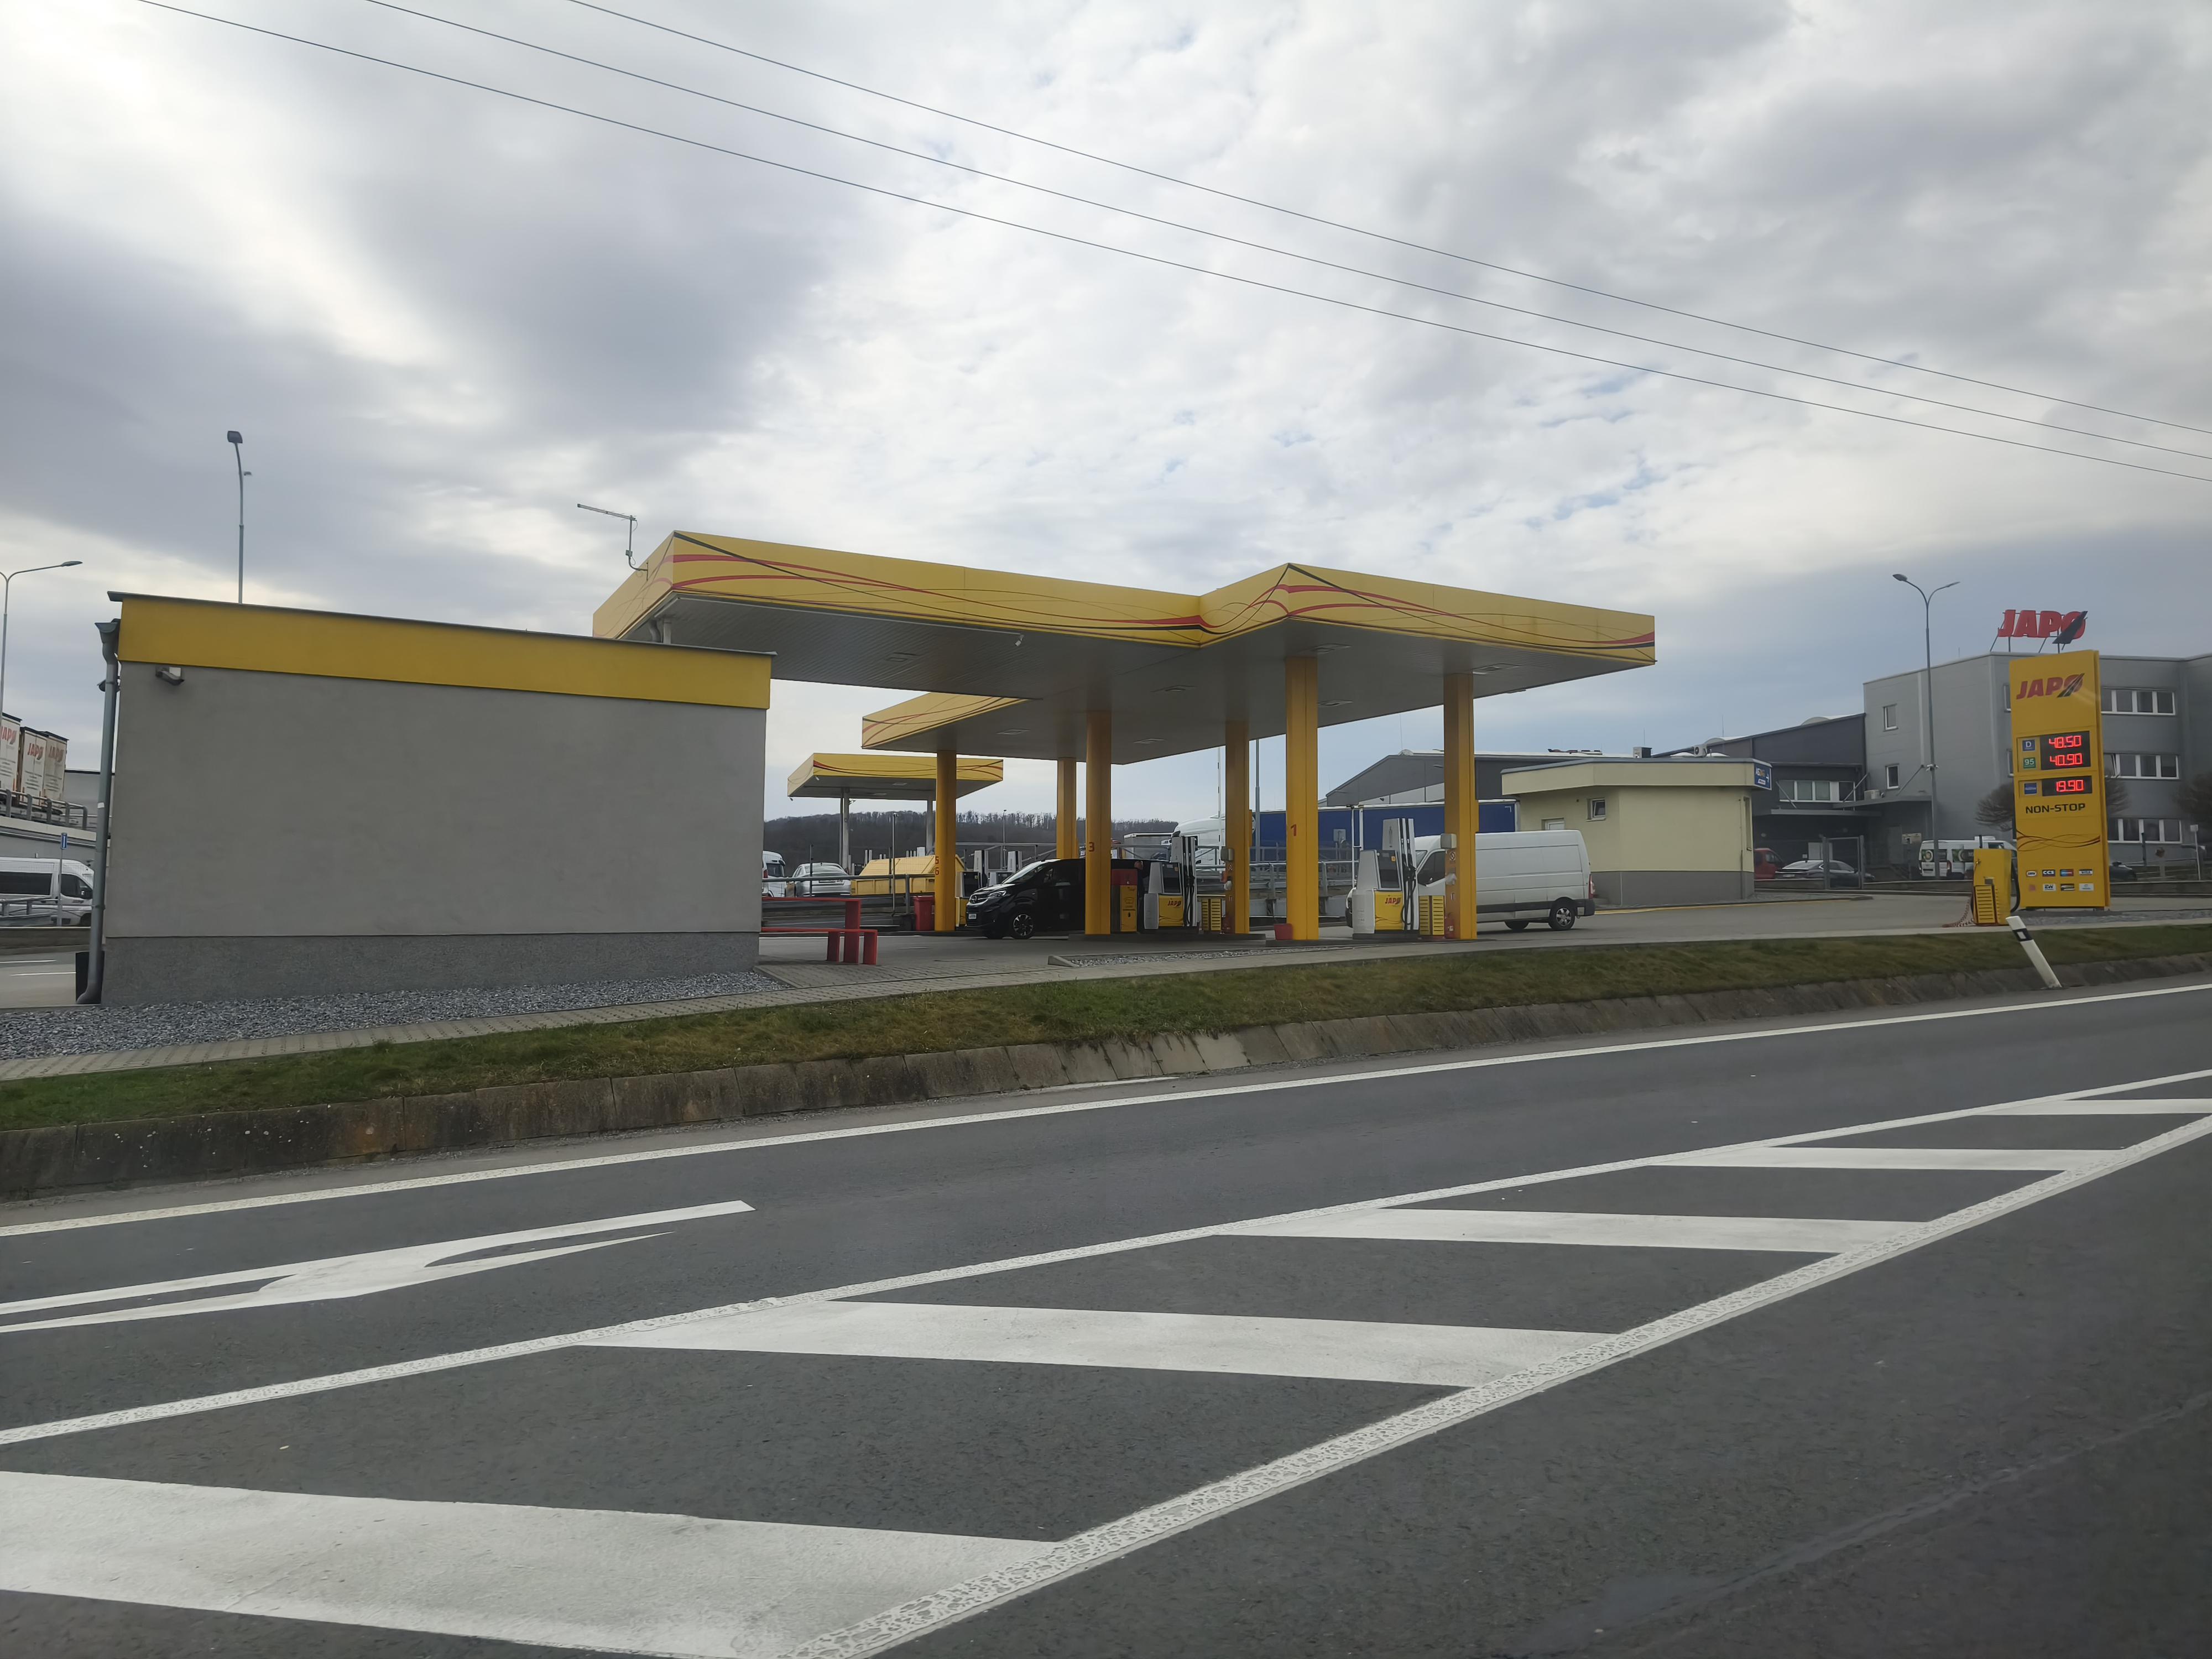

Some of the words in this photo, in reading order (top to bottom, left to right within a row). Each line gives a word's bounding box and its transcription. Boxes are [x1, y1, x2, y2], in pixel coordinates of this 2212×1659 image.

[1997, 609, 2088, 644] JAPO
[2016, 673, 2085, 700] JAPO
[2026, 803, 2086, 813] NON-STOP
[1291, 824, 1297, 836] 1
[1088, 842, 1094, 852] 3
[935, 856, 939, 864] 5
